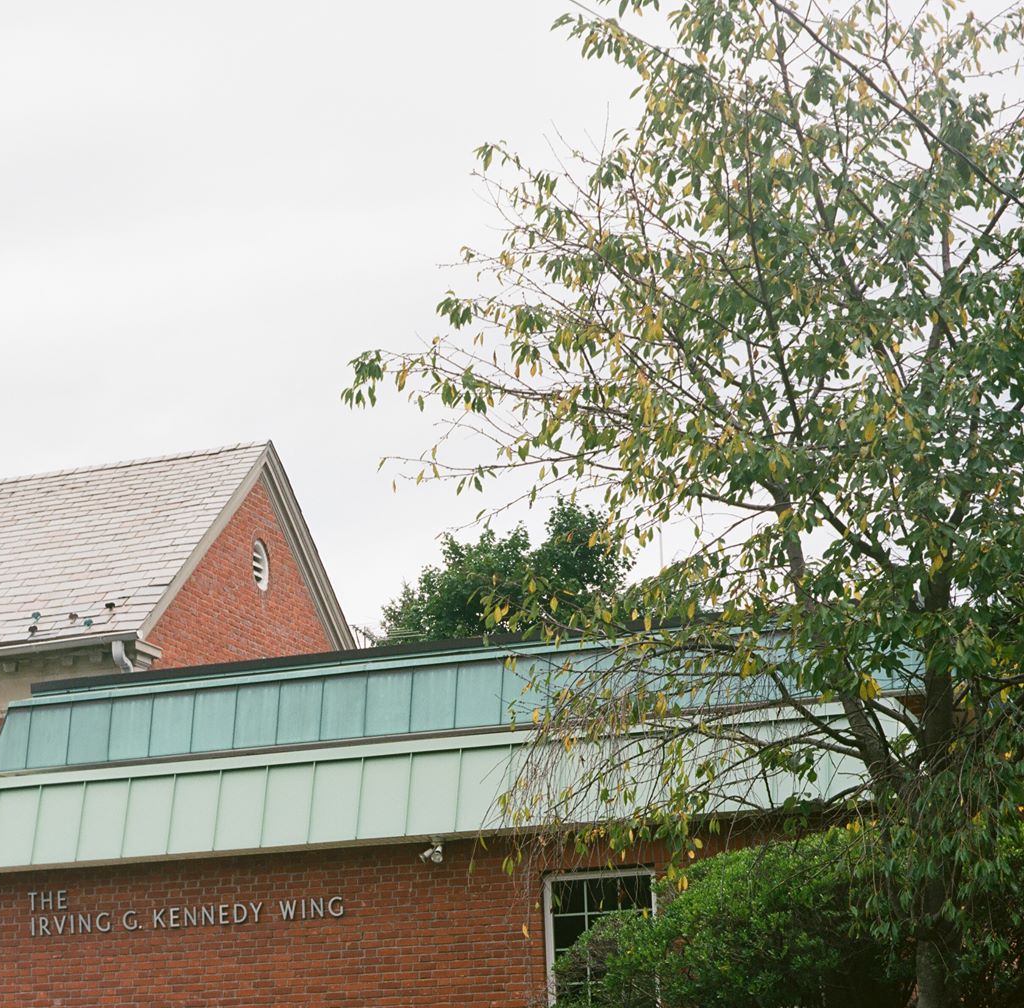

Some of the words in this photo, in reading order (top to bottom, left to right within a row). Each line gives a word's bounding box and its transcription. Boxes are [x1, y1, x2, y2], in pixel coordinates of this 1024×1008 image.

[28, 890, 68, 911] THE
[30, 912, 111, 936] IRVING
[122, 911, 143, 931] G.
[152, 902, 263, 929] KENNEDY
[279, 896, 344, 921] WING
